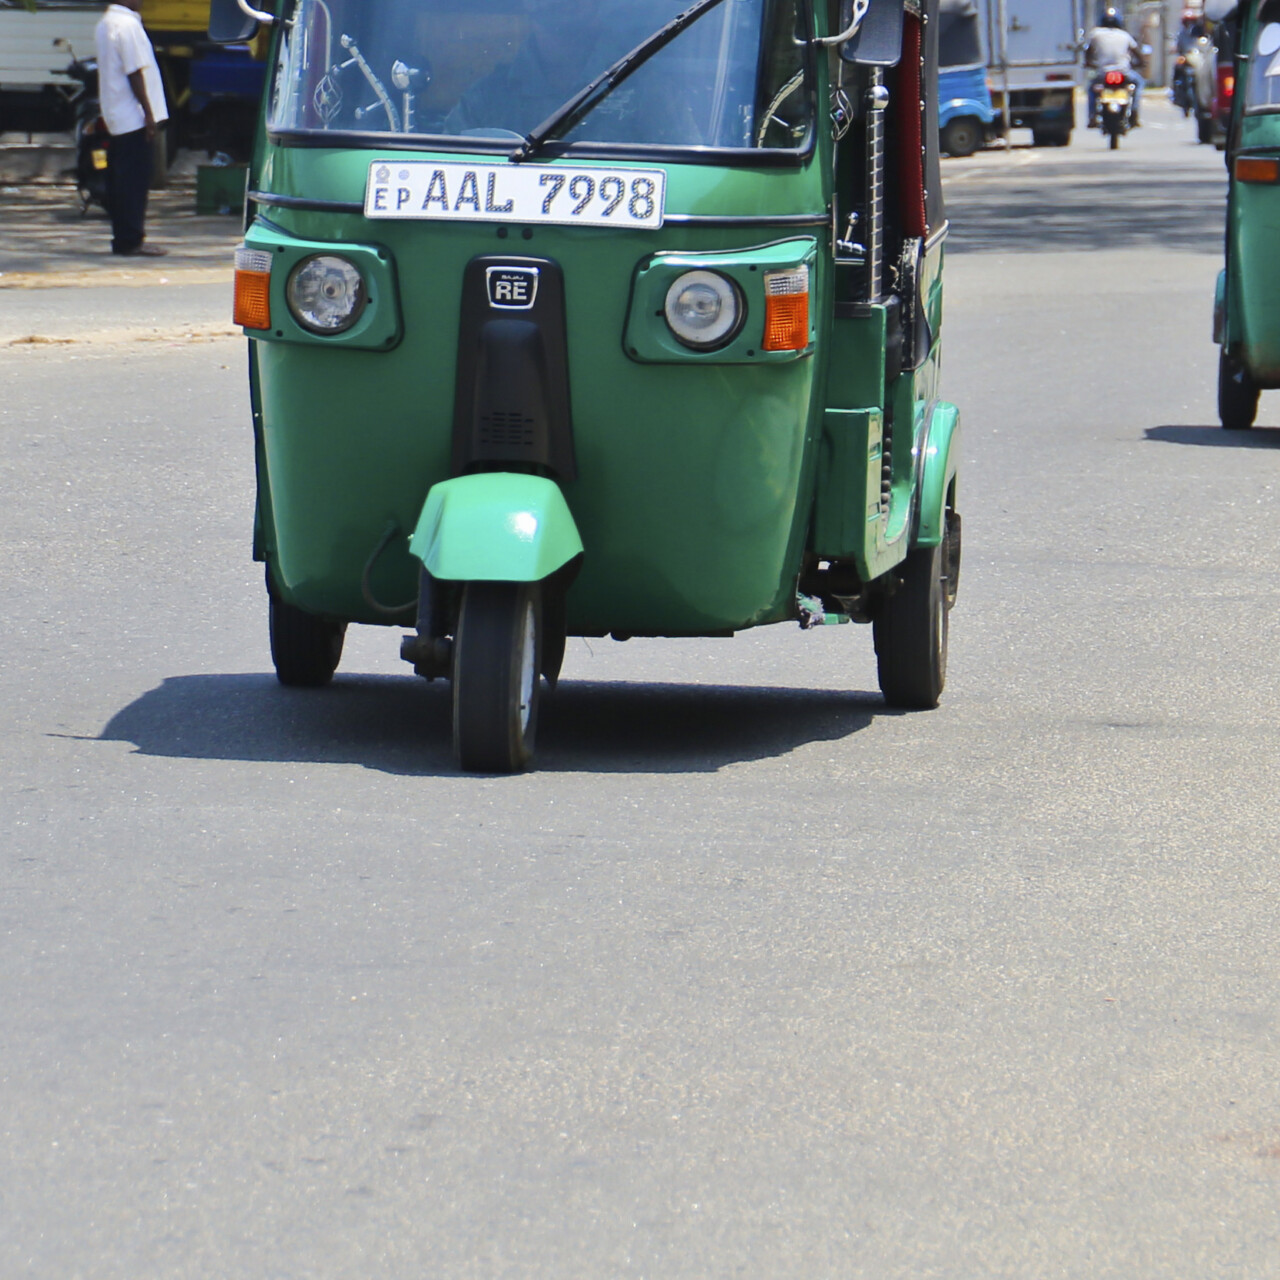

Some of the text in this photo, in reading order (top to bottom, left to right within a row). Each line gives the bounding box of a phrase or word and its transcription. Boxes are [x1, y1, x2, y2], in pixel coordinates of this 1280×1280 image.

[422, 169, 514, 213] AAL
[538, 173, 656, 220] 7998
[494, 281, 528, 300] RE
